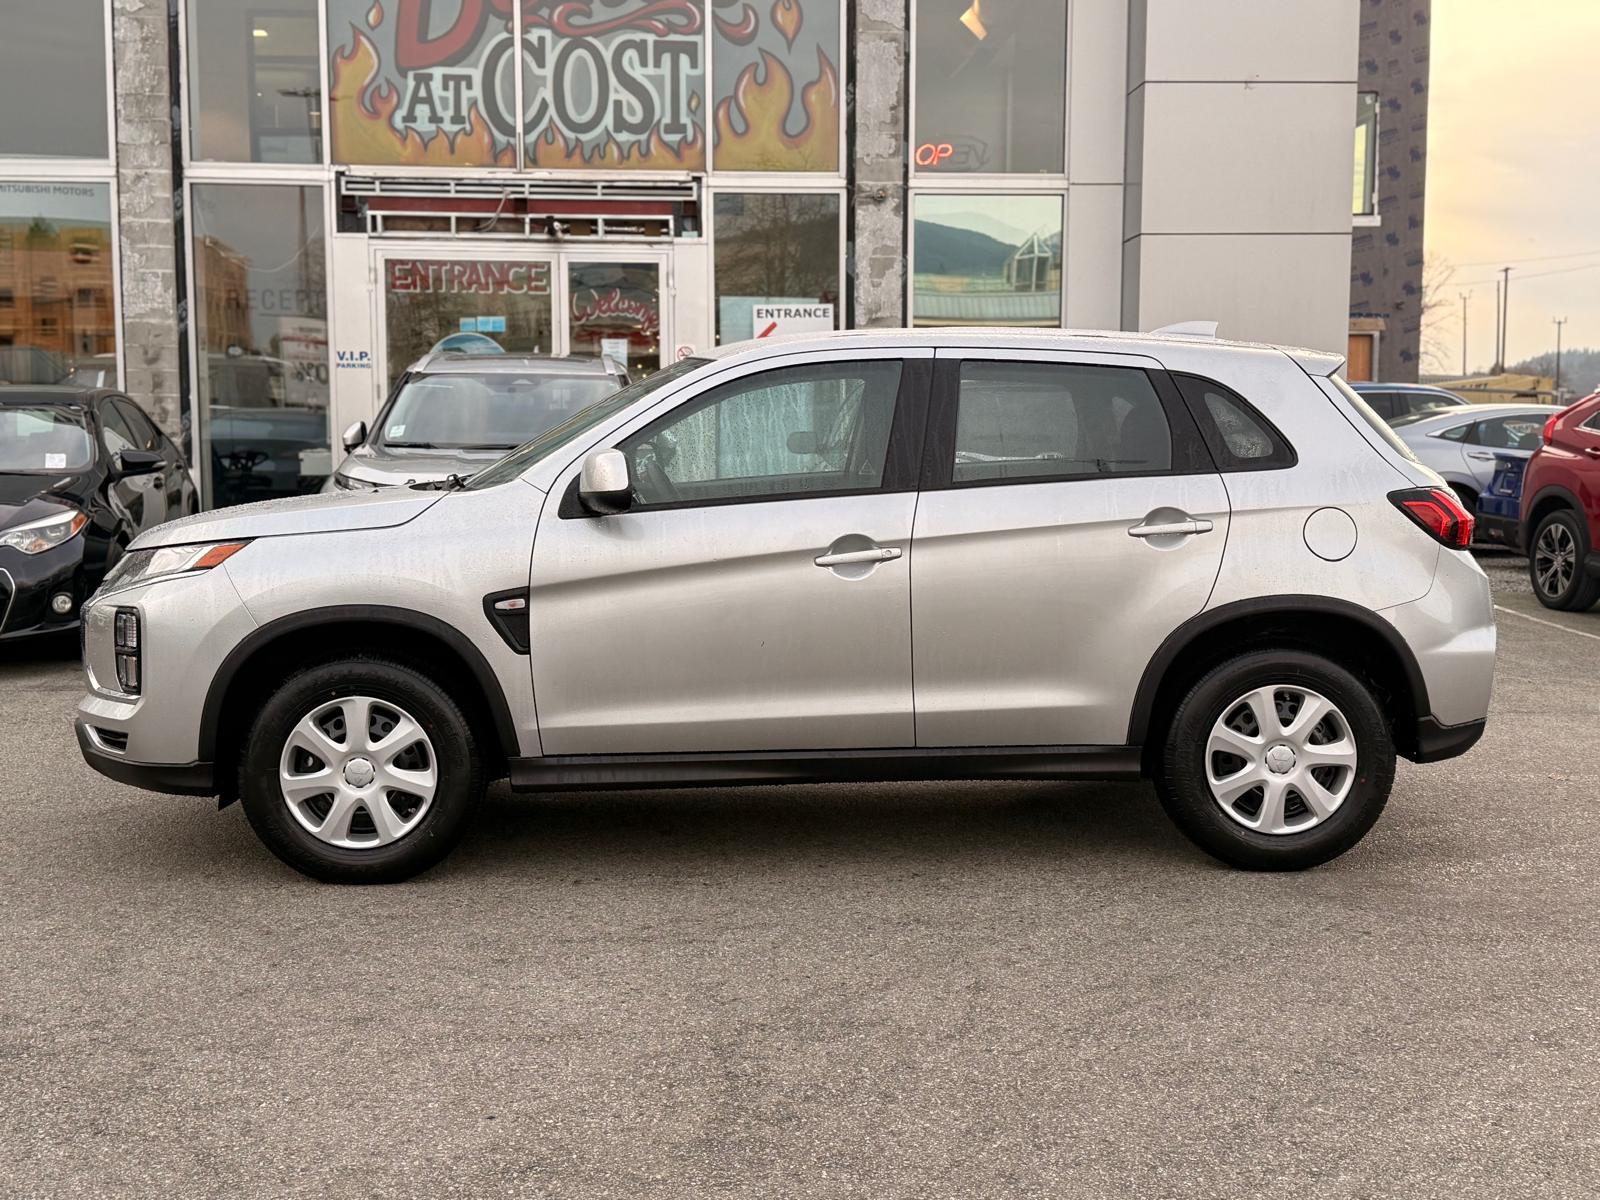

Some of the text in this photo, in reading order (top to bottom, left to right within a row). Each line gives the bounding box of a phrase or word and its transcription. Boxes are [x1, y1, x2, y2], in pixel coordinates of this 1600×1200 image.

[401, 72, 473, 125] AT
[481, 35, 699, 136] COST
[52, 185, 96, 198] MOTORS
[390, 261, 551, 295] ENTRANCE
[569, 287, 660, 336] Welcome
[756, 307, 831, 319] ENTRANCE
[337, 351, 371, 361] V.I.P.
